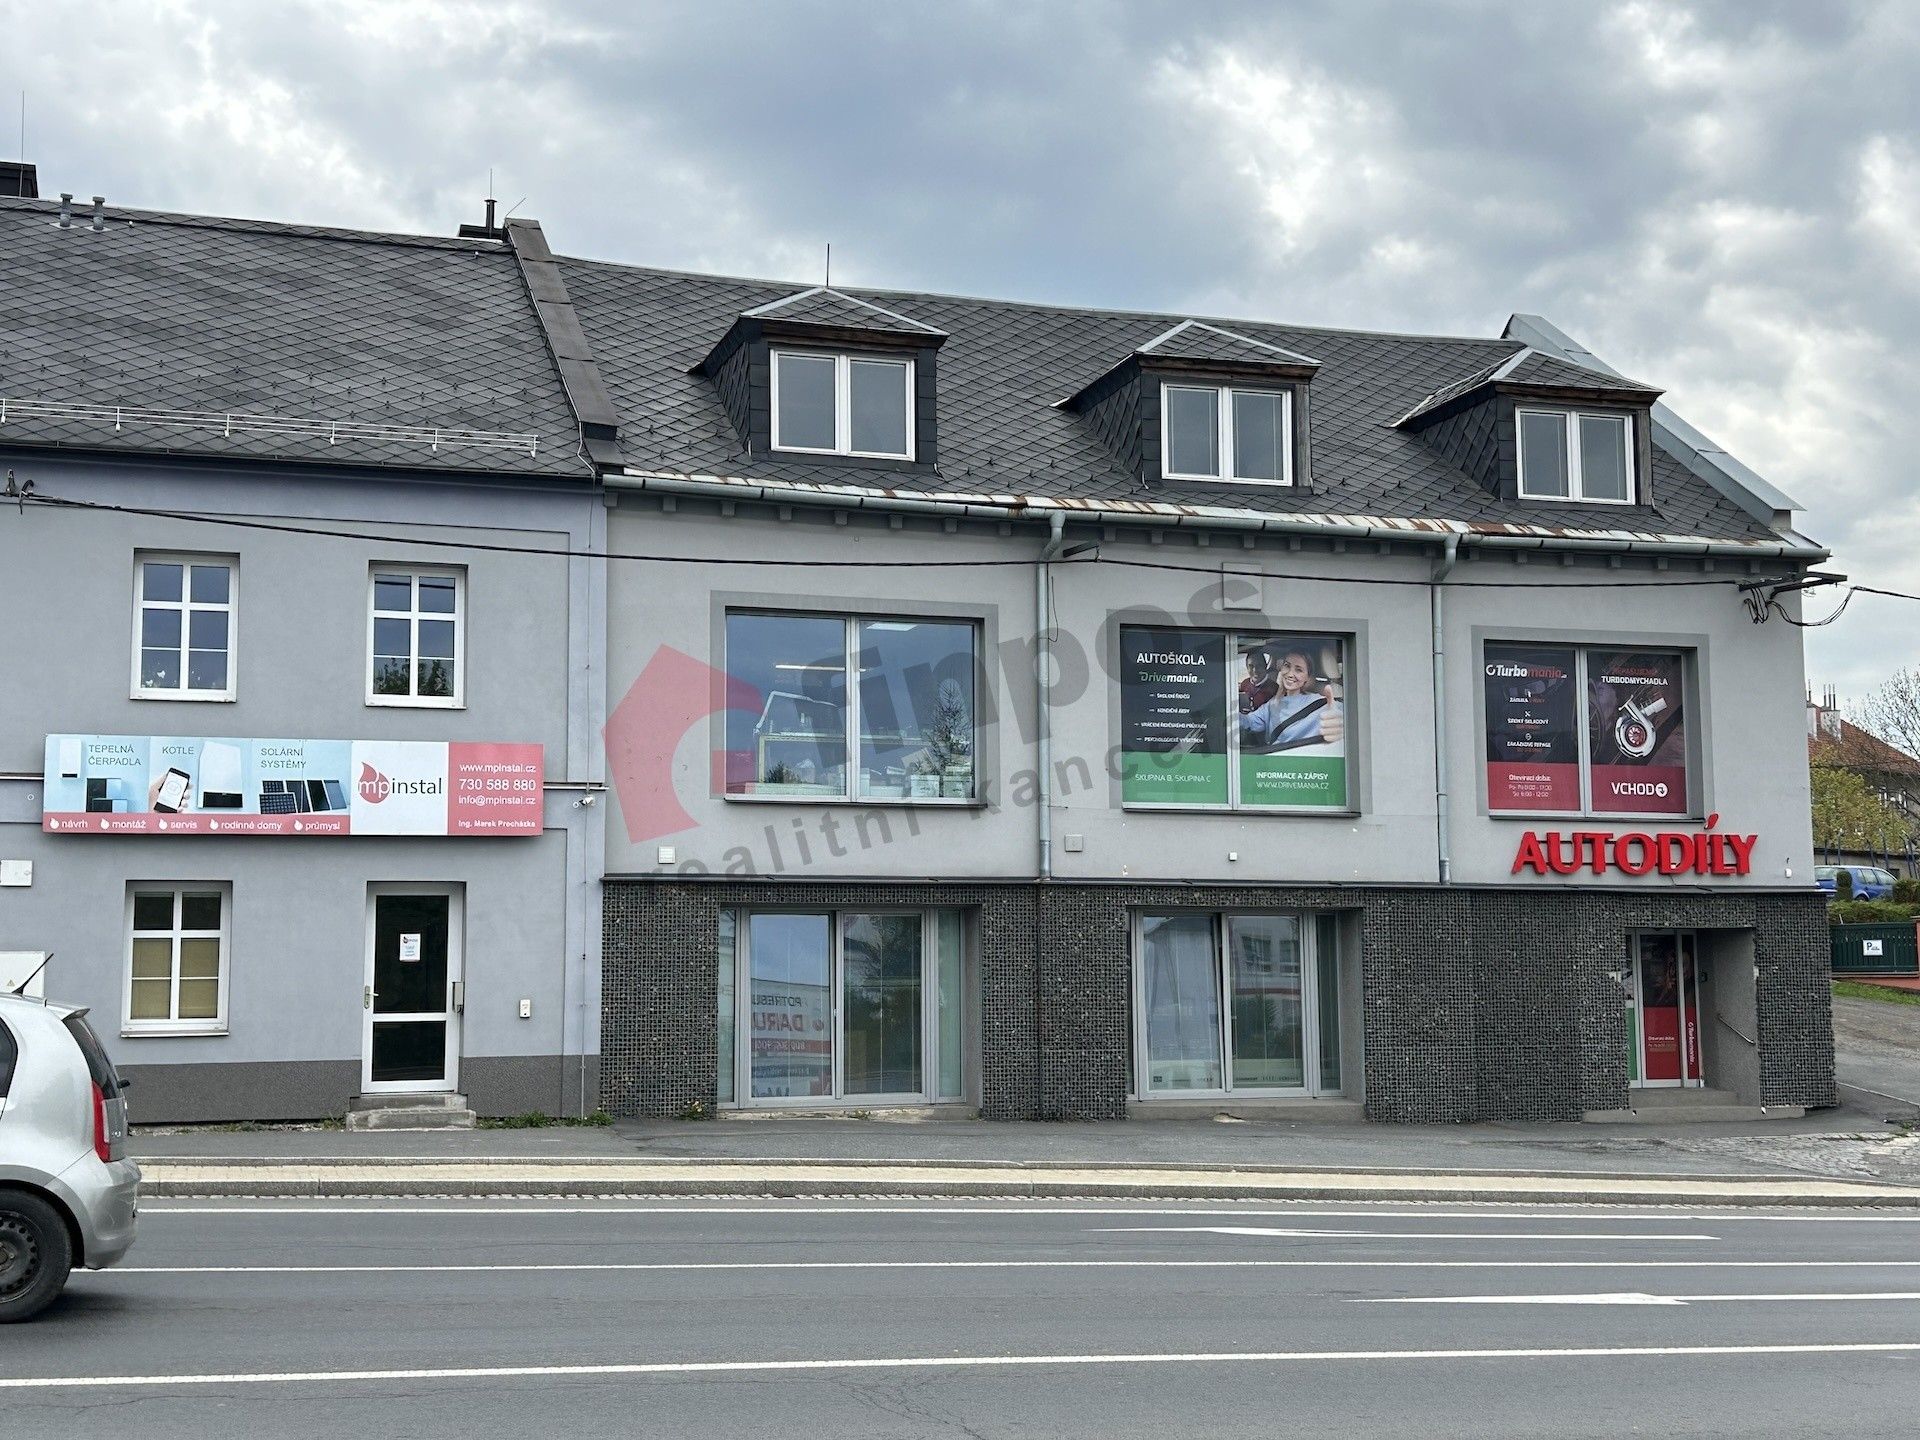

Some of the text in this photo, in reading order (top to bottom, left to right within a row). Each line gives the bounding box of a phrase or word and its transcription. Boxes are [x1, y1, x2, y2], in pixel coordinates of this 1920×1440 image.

[1137, 651, 1206, 665] AUTOŠKOLA
[1601, 675, 1668, 686] TURBODMYCHADLA
[88, 743, 135, 754] TEPELNÁ
[162, 746, 194, 755] KOTLE
[260, 747, 304, 756] SOLÁRNÍ
[88, 755, 142, 766] ČERPADLA
[260, 759, 307, 769] SYSTÉMY
[459, 763, 536, 773] www.mpinstal.cz
[1135, 773, 1166, 781] SKUPINA
[1206, 775, 1211, 783] C
[1256, 771, 1296, 780] INFORMACE
[1303, 771, 1329, 780] ZÁPISY
[359, 777, 442, 798] mpinstal
[459, 778, 536, 791] 730 588 880
[1256, 781, 1329, 790] WWW.DRIVEMANIA.CZ
[1611, 782, 1655, 796] VCHOD
[458, 795, 536, 806] info@mpinstal.cz
[61, 819, 88, 829] návrh
[112, 819, 147, 829] montáž
[170, 820, 197, 829] servis
[221, 821, 282, 831] rodinné domy
[305, 820, 341, 831] průmysl
[458, 820, 472, 828] Ing.
[498, 820, 536, 828] Procházka
[1512, 813, 1758, 876] AUTODÍLY
